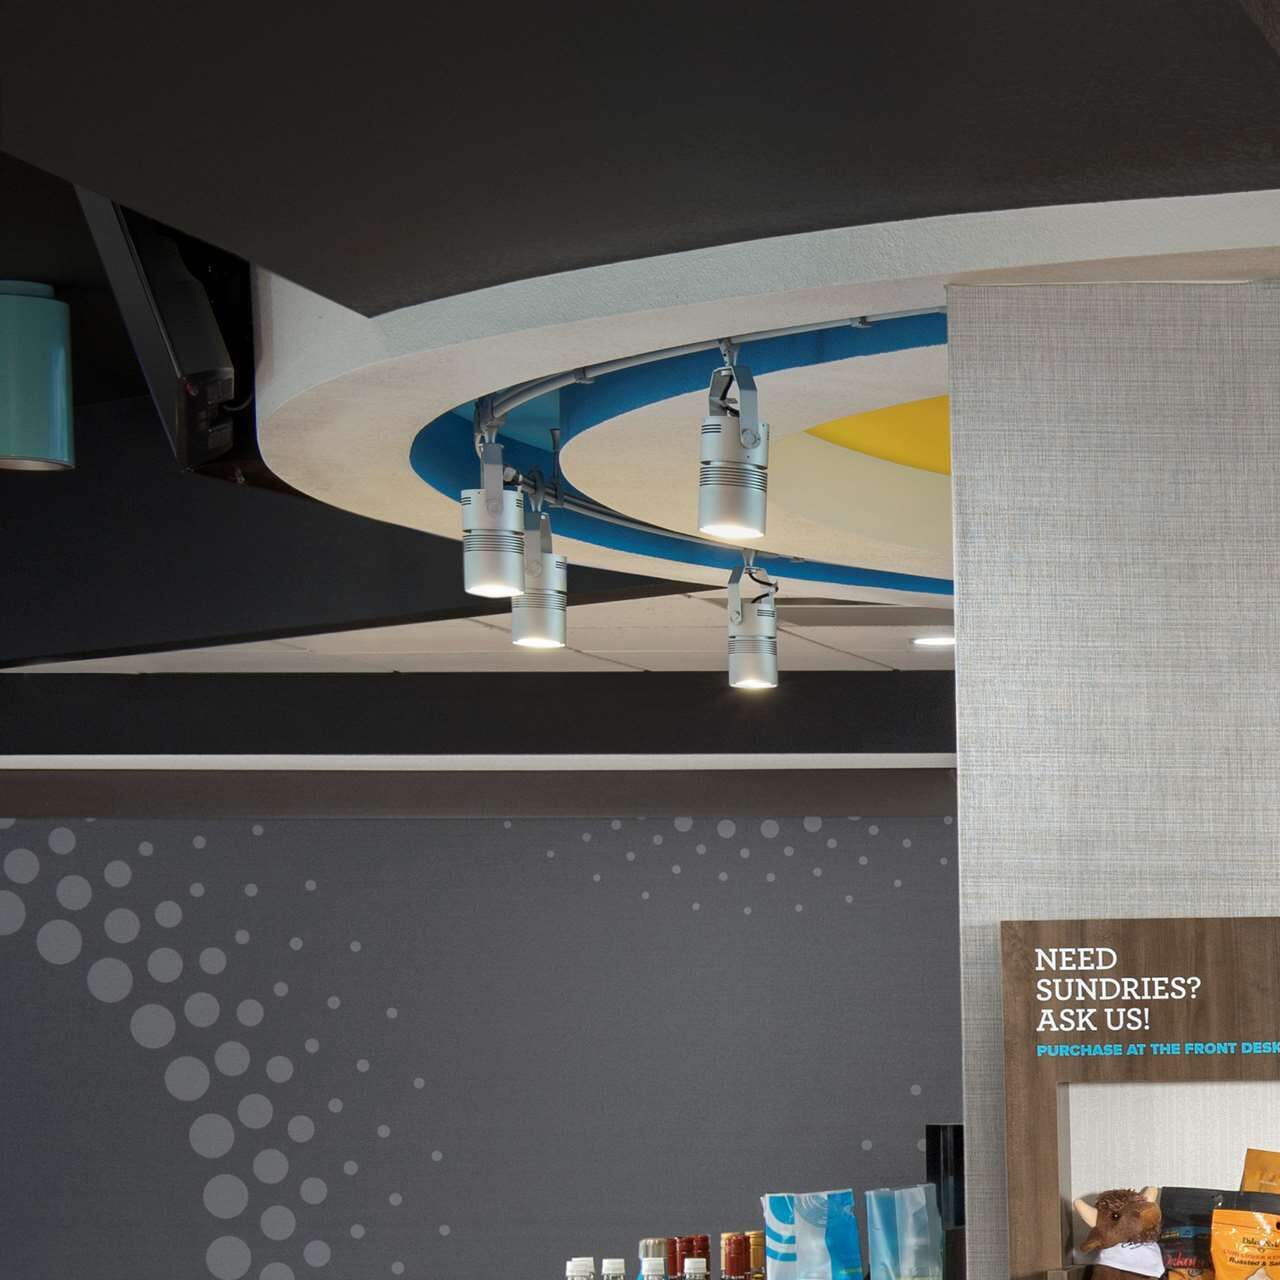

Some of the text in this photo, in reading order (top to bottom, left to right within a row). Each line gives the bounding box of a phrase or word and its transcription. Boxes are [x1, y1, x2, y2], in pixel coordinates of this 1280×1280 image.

[1034, 947, 1118, 971] NEED
[1036, 976, 1202, 1001] SUNDRIES?
[1036, 1007, 1151, 1032] ASK US!
[1036, 1044, 1123, 1057] PURCHASE
[1126, 1043, 1147, 1056] AT
[1150, 1043, 1181, 1055] THE
[1184, 1042, 1238, 1055] FRONT
